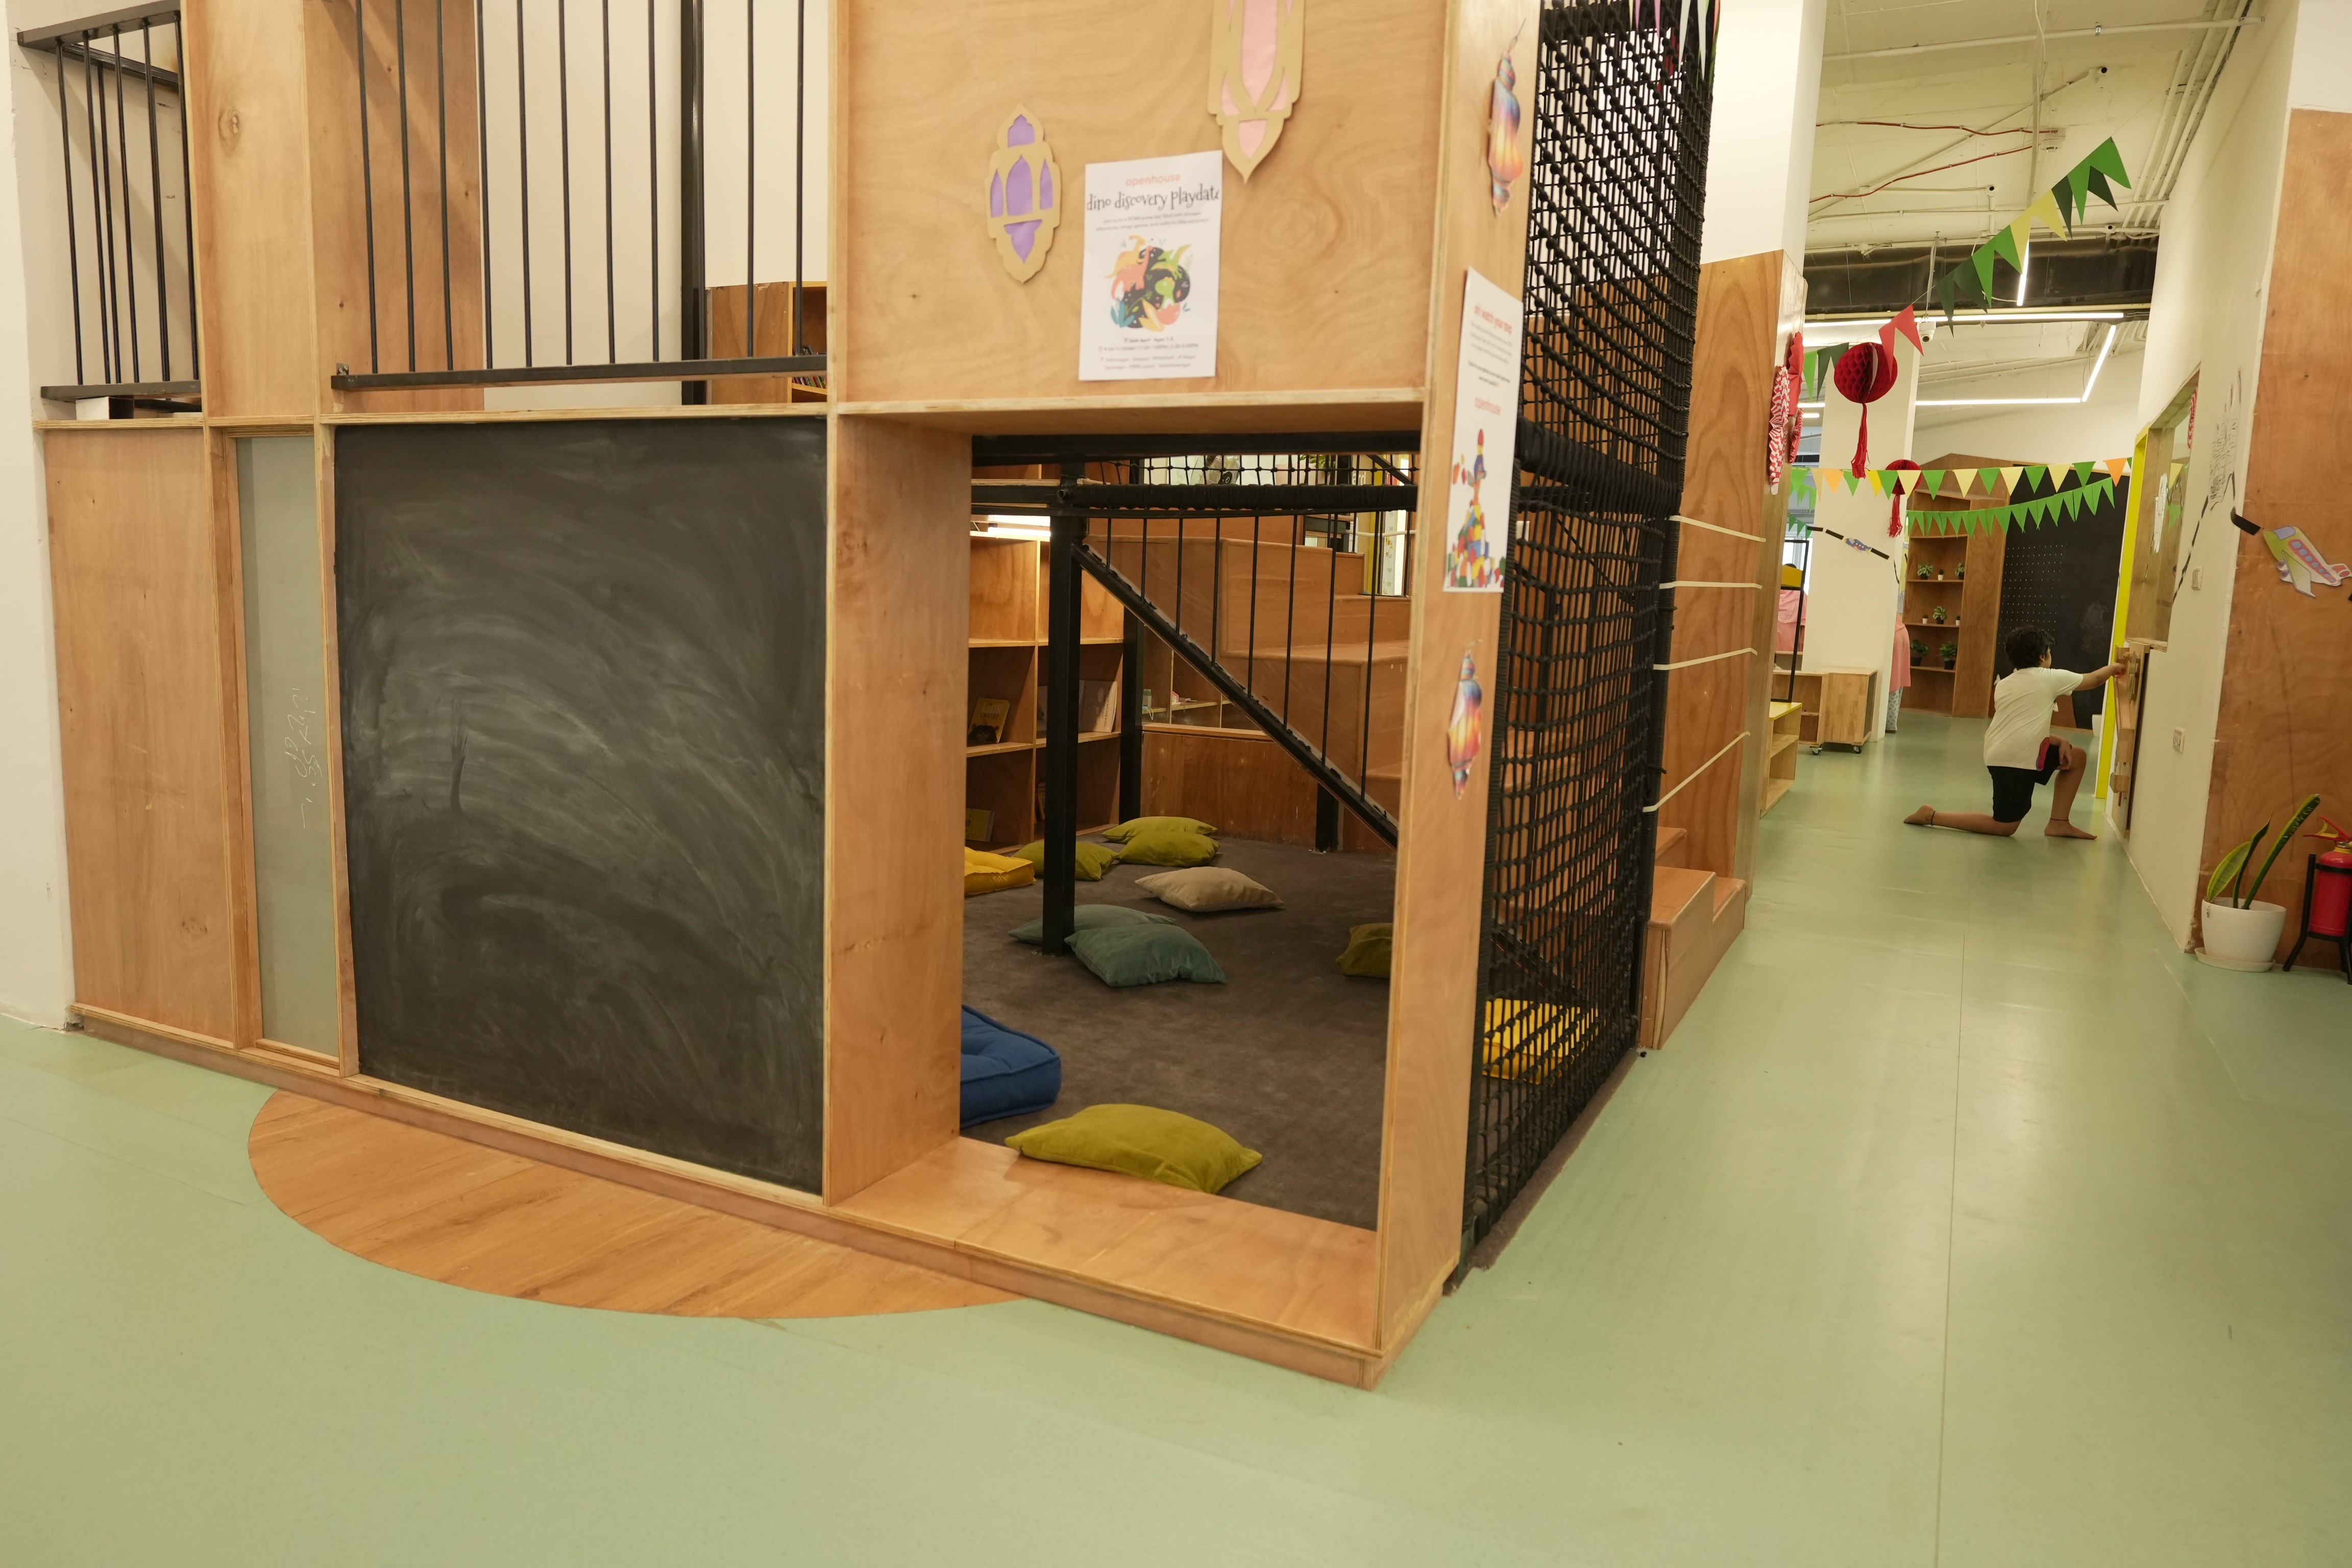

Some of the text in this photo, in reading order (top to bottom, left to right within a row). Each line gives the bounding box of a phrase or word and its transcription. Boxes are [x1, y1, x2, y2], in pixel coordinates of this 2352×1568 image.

[1125, 174, 1181, 187] openhouse
[1087, 193, 1112, 211] dino
[1115, 191, 1168, 211] discovery
